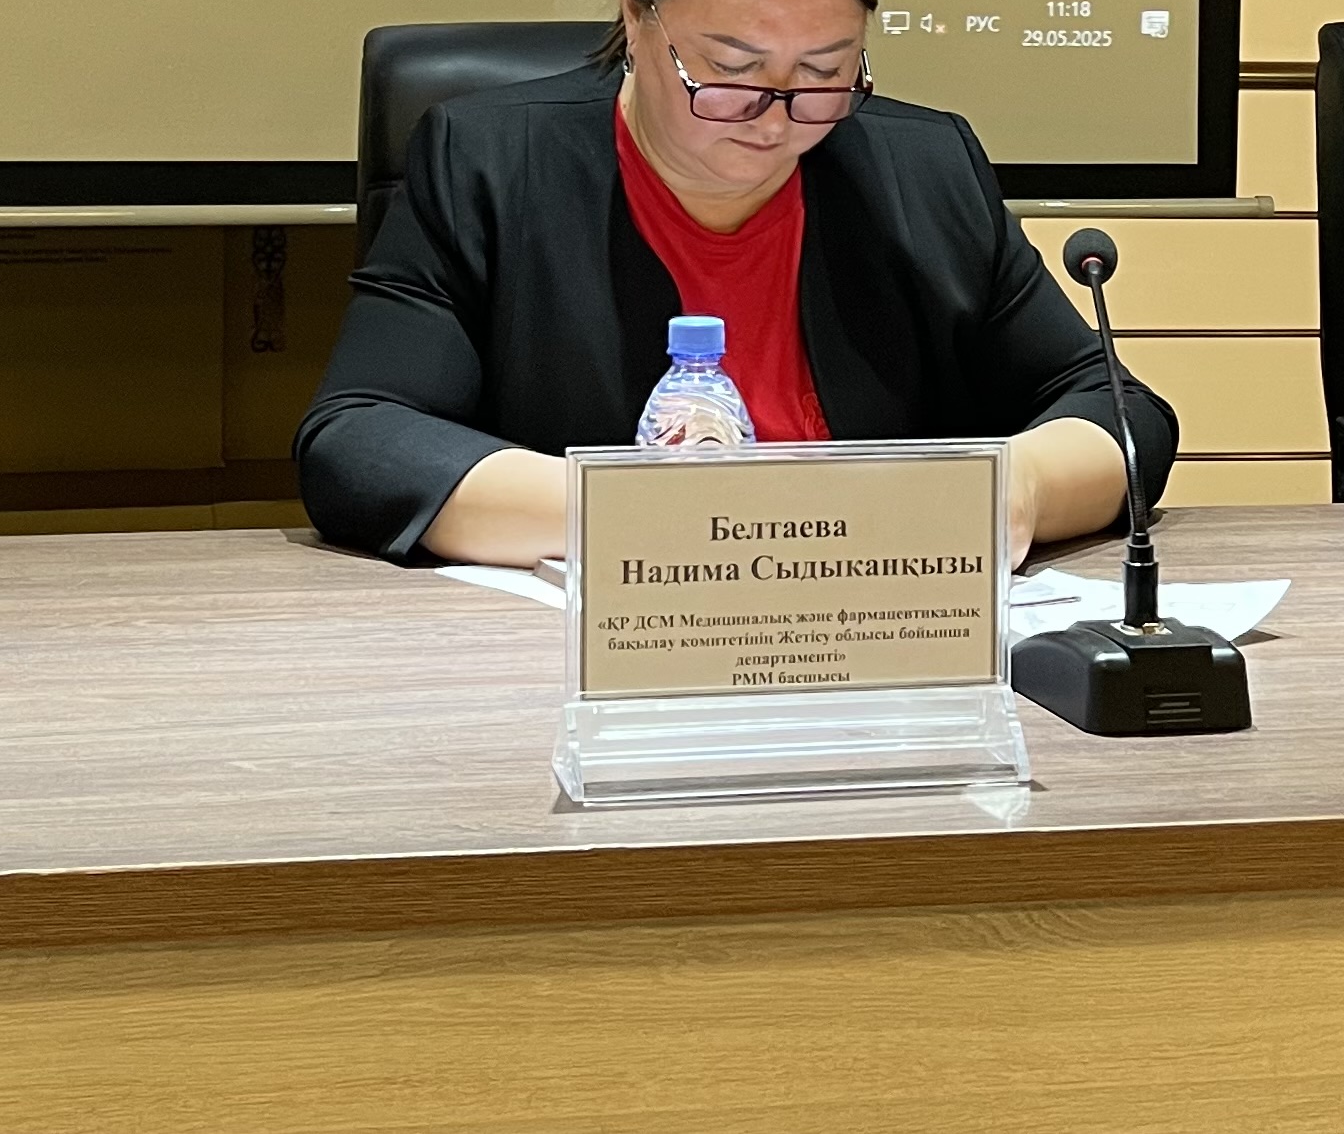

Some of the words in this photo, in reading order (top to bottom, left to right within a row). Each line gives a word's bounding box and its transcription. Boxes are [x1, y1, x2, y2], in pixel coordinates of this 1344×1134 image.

[1046, 0, 1092, 18] 11:18
[966, 15, 1001, 33] РУС
[1022, 29, 1113, 48] 29.05.2025
[710, 515, 849, 543] Белтаева
[621, 559, 740, 587] Надима
[751, 554, 984, 582] Сыдыканқызы
[633, 615, 675, 632] ДСМ
[679, 613, 793, 629] Медициналық
[608, 637, 676, 652] бақылау
[778, 629, 830, 646] Жетісу
[835, 628, 895, 642] облысы
[899, 626, 971, 640] бойынша
[732, 672, 773, 686] РММ
[778, 671, 851, 685] басшысы
